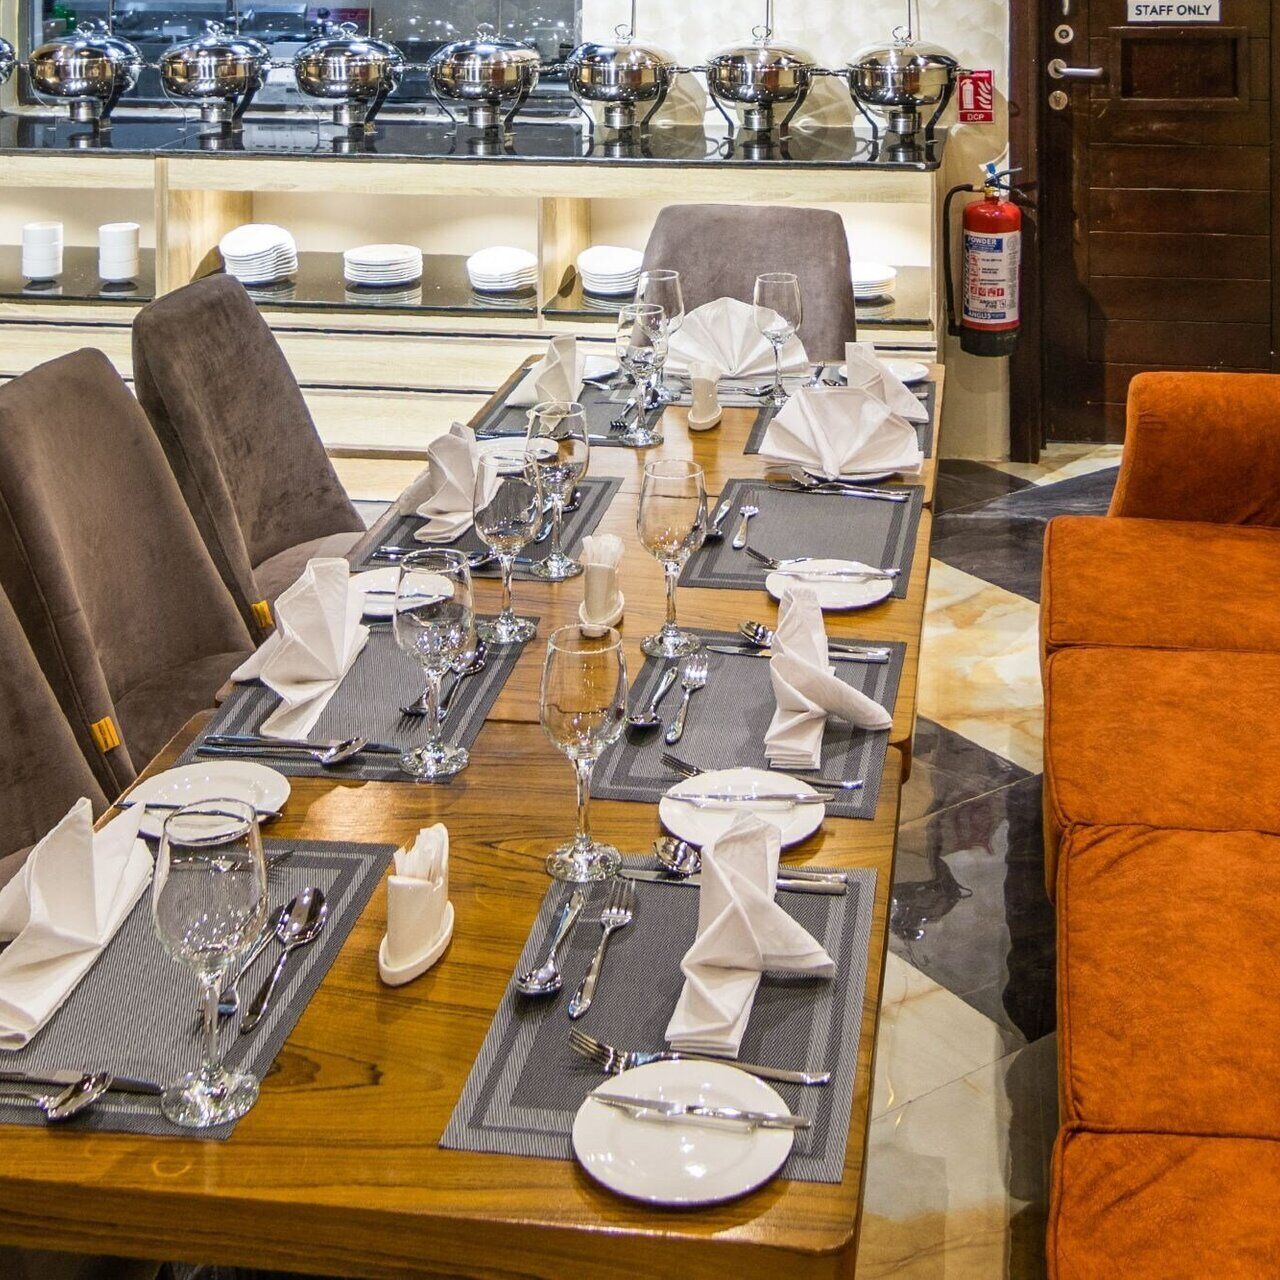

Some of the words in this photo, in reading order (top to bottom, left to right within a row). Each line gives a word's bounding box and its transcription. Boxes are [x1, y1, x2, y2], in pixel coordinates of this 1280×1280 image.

[1134, 4, 1174, 16] STAFF
[1176, 4, 1212, 16] ONLY
[966, 113, 985, 121] DCP
